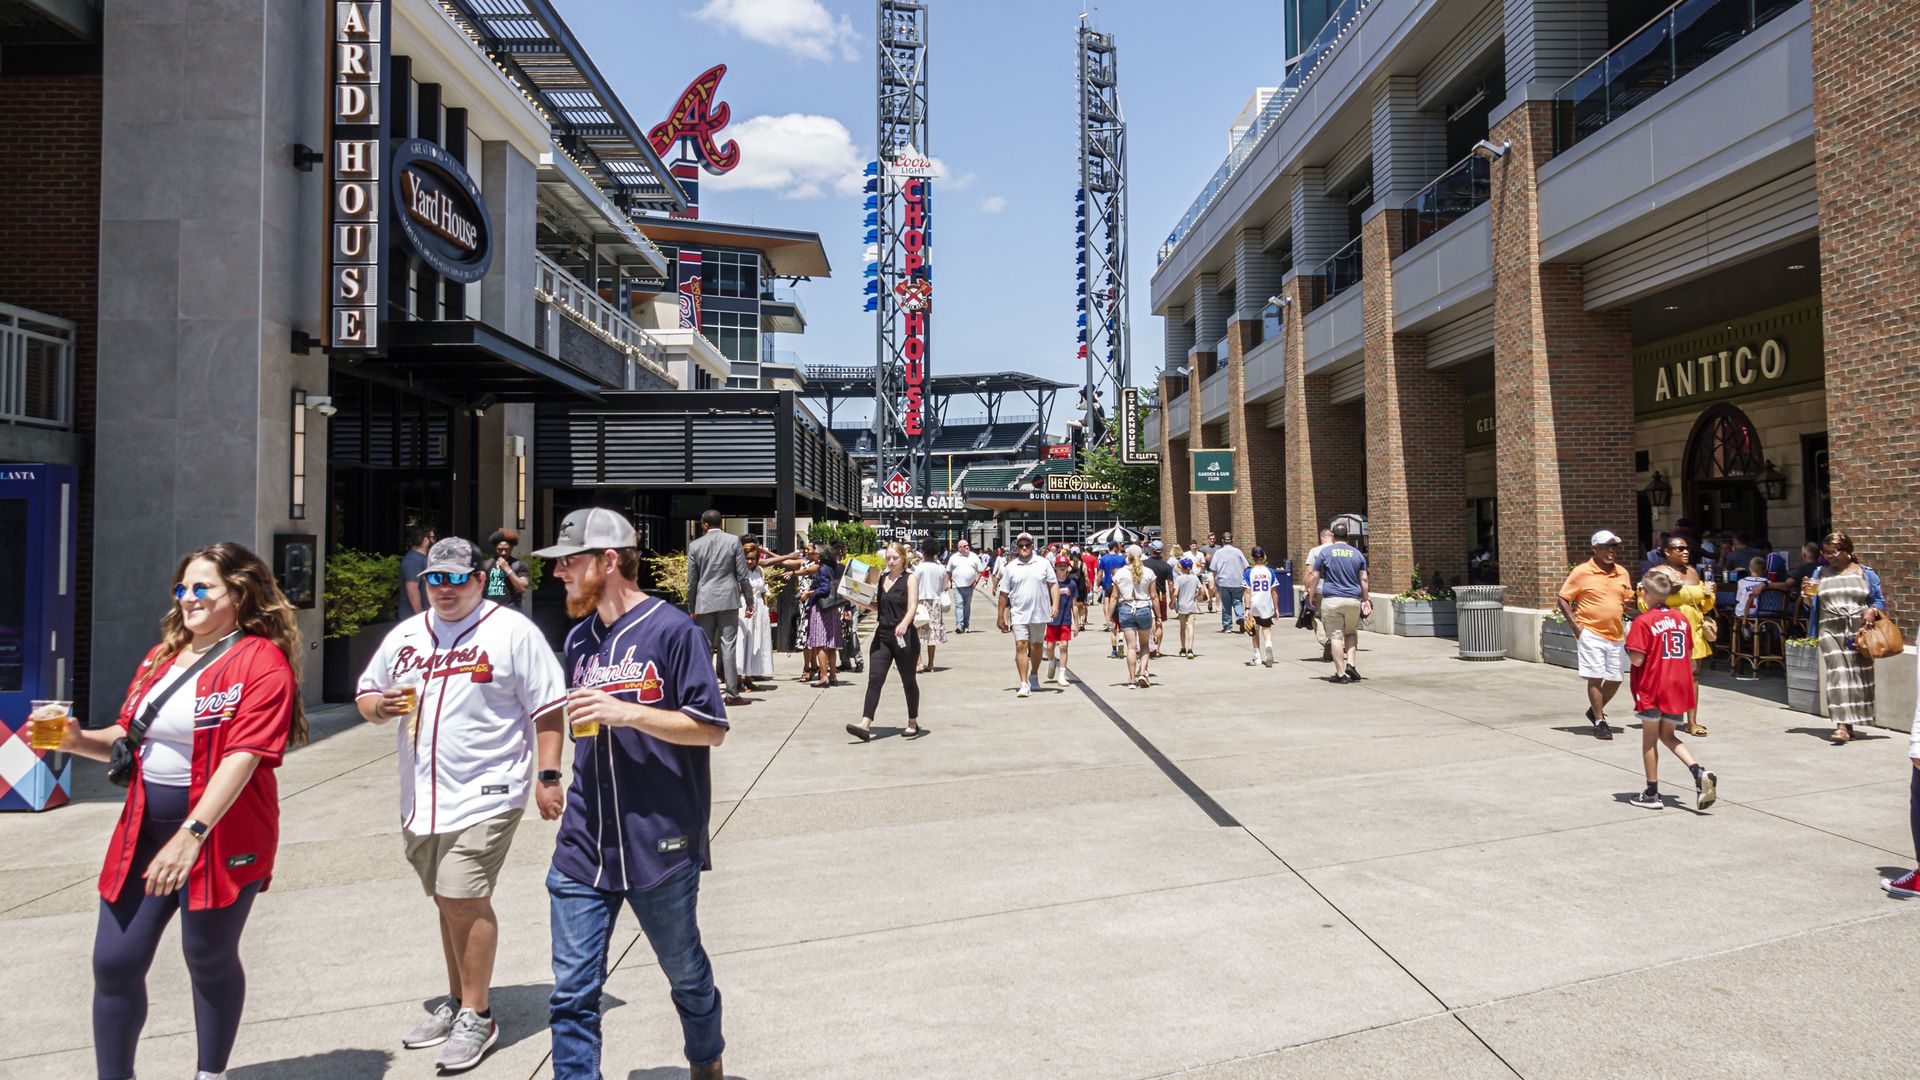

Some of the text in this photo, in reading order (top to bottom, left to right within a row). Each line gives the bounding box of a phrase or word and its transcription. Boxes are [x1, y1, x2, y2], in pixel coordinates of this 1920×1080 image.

[895, 153, 932, 168] Coors
[408, 171, 439, 225] Yard
[441, 194, 478, 251] House
[339, 142, 367, 341] HOUSE
[904, 178, 923, 276] CHOP
[904, 313, 923, 435] HOUSE
[1655, 339, 1786, 402] ANTICO
[1128, 392, 1136, 453] STEAKHOUSE
[889, 480, 907, 494] CH
[1050, 477, 1069, 488] H&F
[872, 495, 924, 509] HOUSE
[926, 495, 965, 509] GATE
[1332, 549, 1354, 558] STAFF
[1252, 580, 1269, 592] 28
[1650, 616, 1677, 636] ACUÑA
[1662, 631, 1685, 659] 13
[392, 645, 479, 680] Braves
[572, 645, 643, 689] Atlanta
